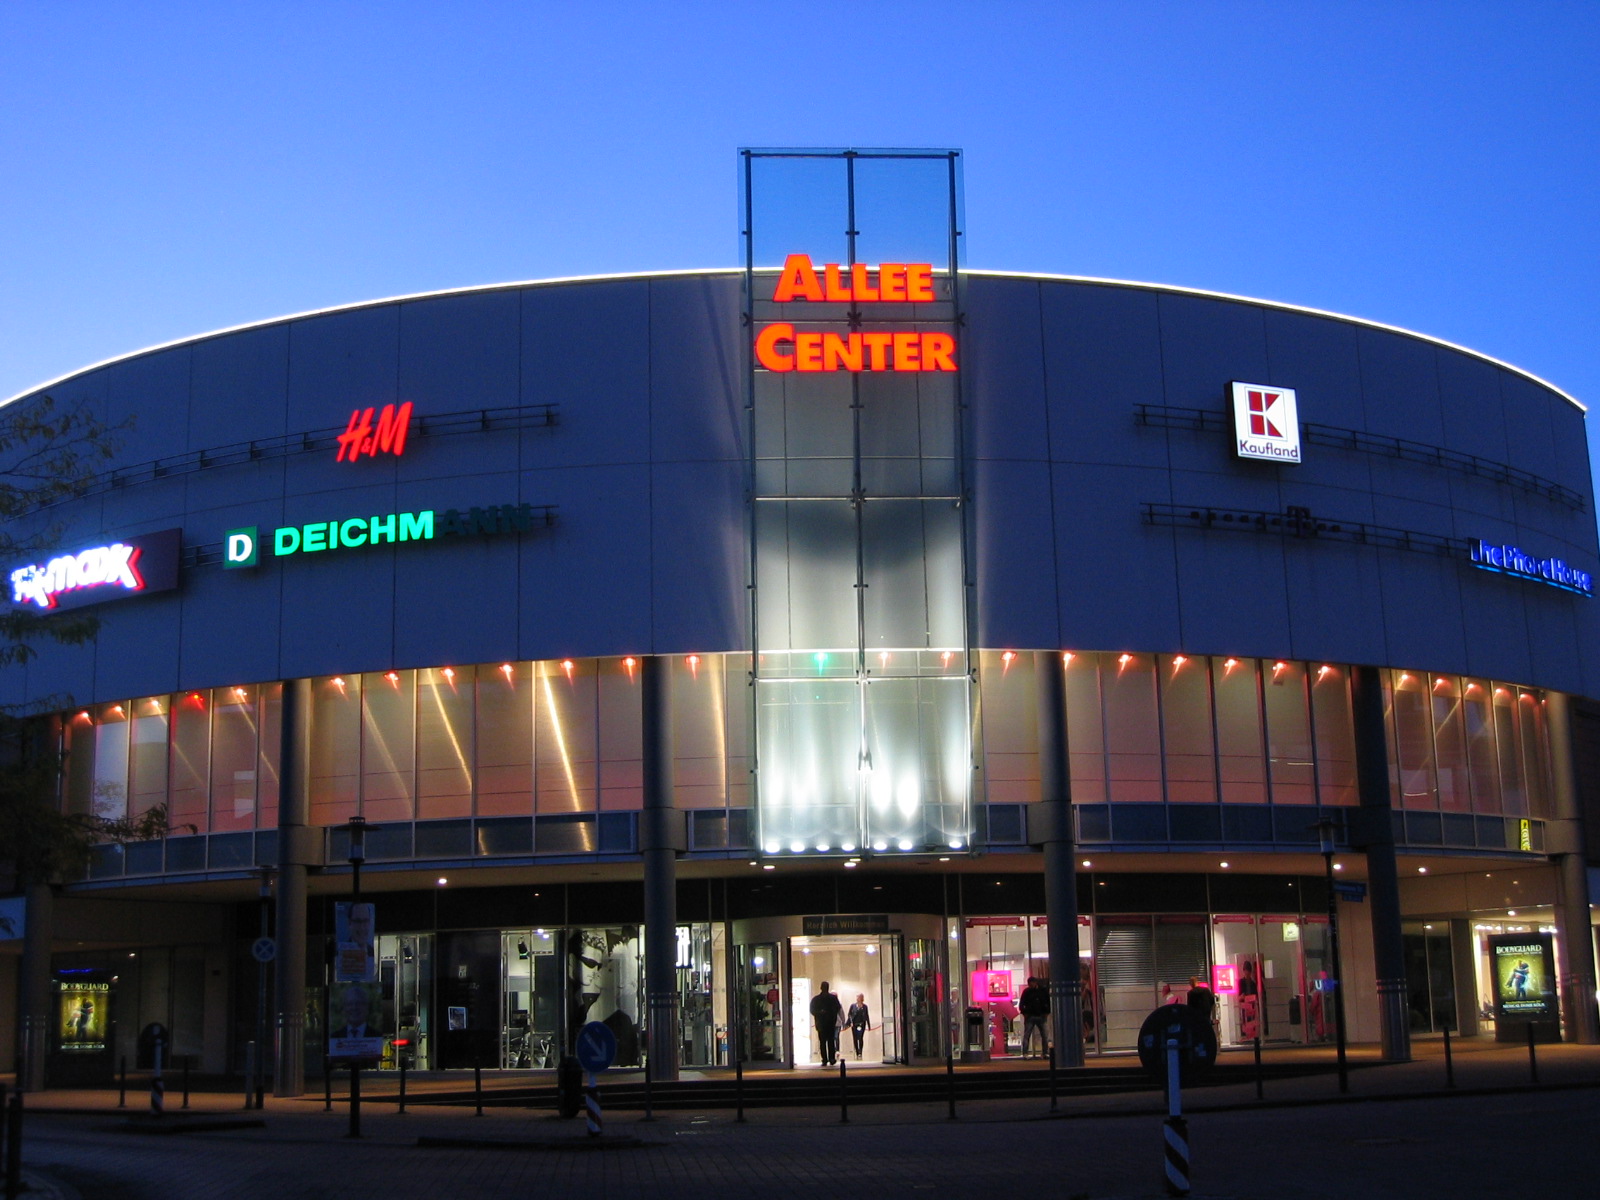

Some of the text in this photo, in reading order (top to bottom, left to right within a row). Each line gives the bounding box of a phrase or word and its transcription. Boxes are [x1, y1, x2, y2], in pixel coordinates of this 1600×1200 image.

[336, 401, 414, 463] H&M
[1239, 439, 1299, 458] Kaufland
[1495, 945, 1543, 954] BODYGUARD
